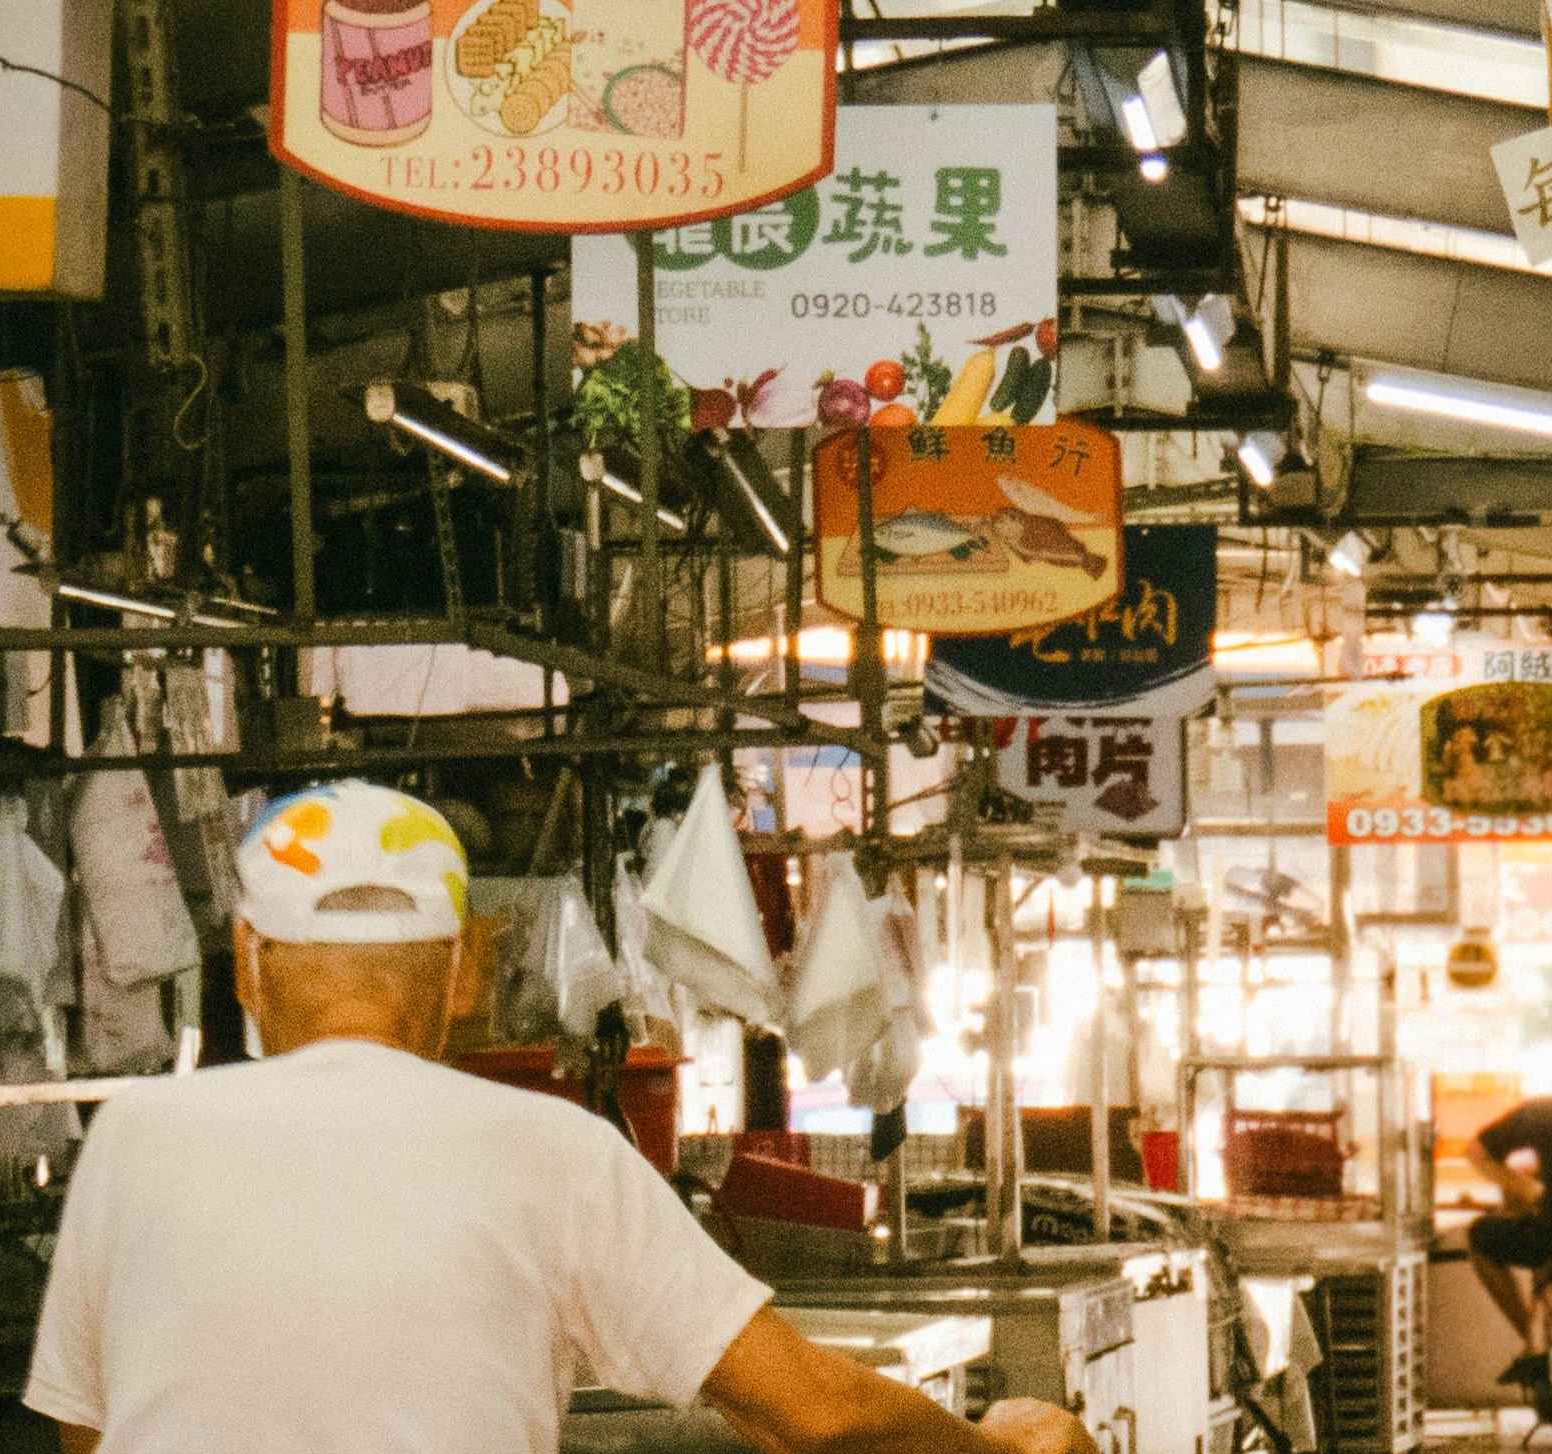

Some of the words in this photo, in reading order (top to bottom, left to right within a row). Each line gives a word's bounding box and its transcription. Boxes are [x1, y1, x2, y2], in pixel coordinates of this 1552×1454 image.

[655, 280, 766, 300] EGETABLE
[655, 306, 712, 325] TORE
[791, 292, 997, 320] 0920-423818
